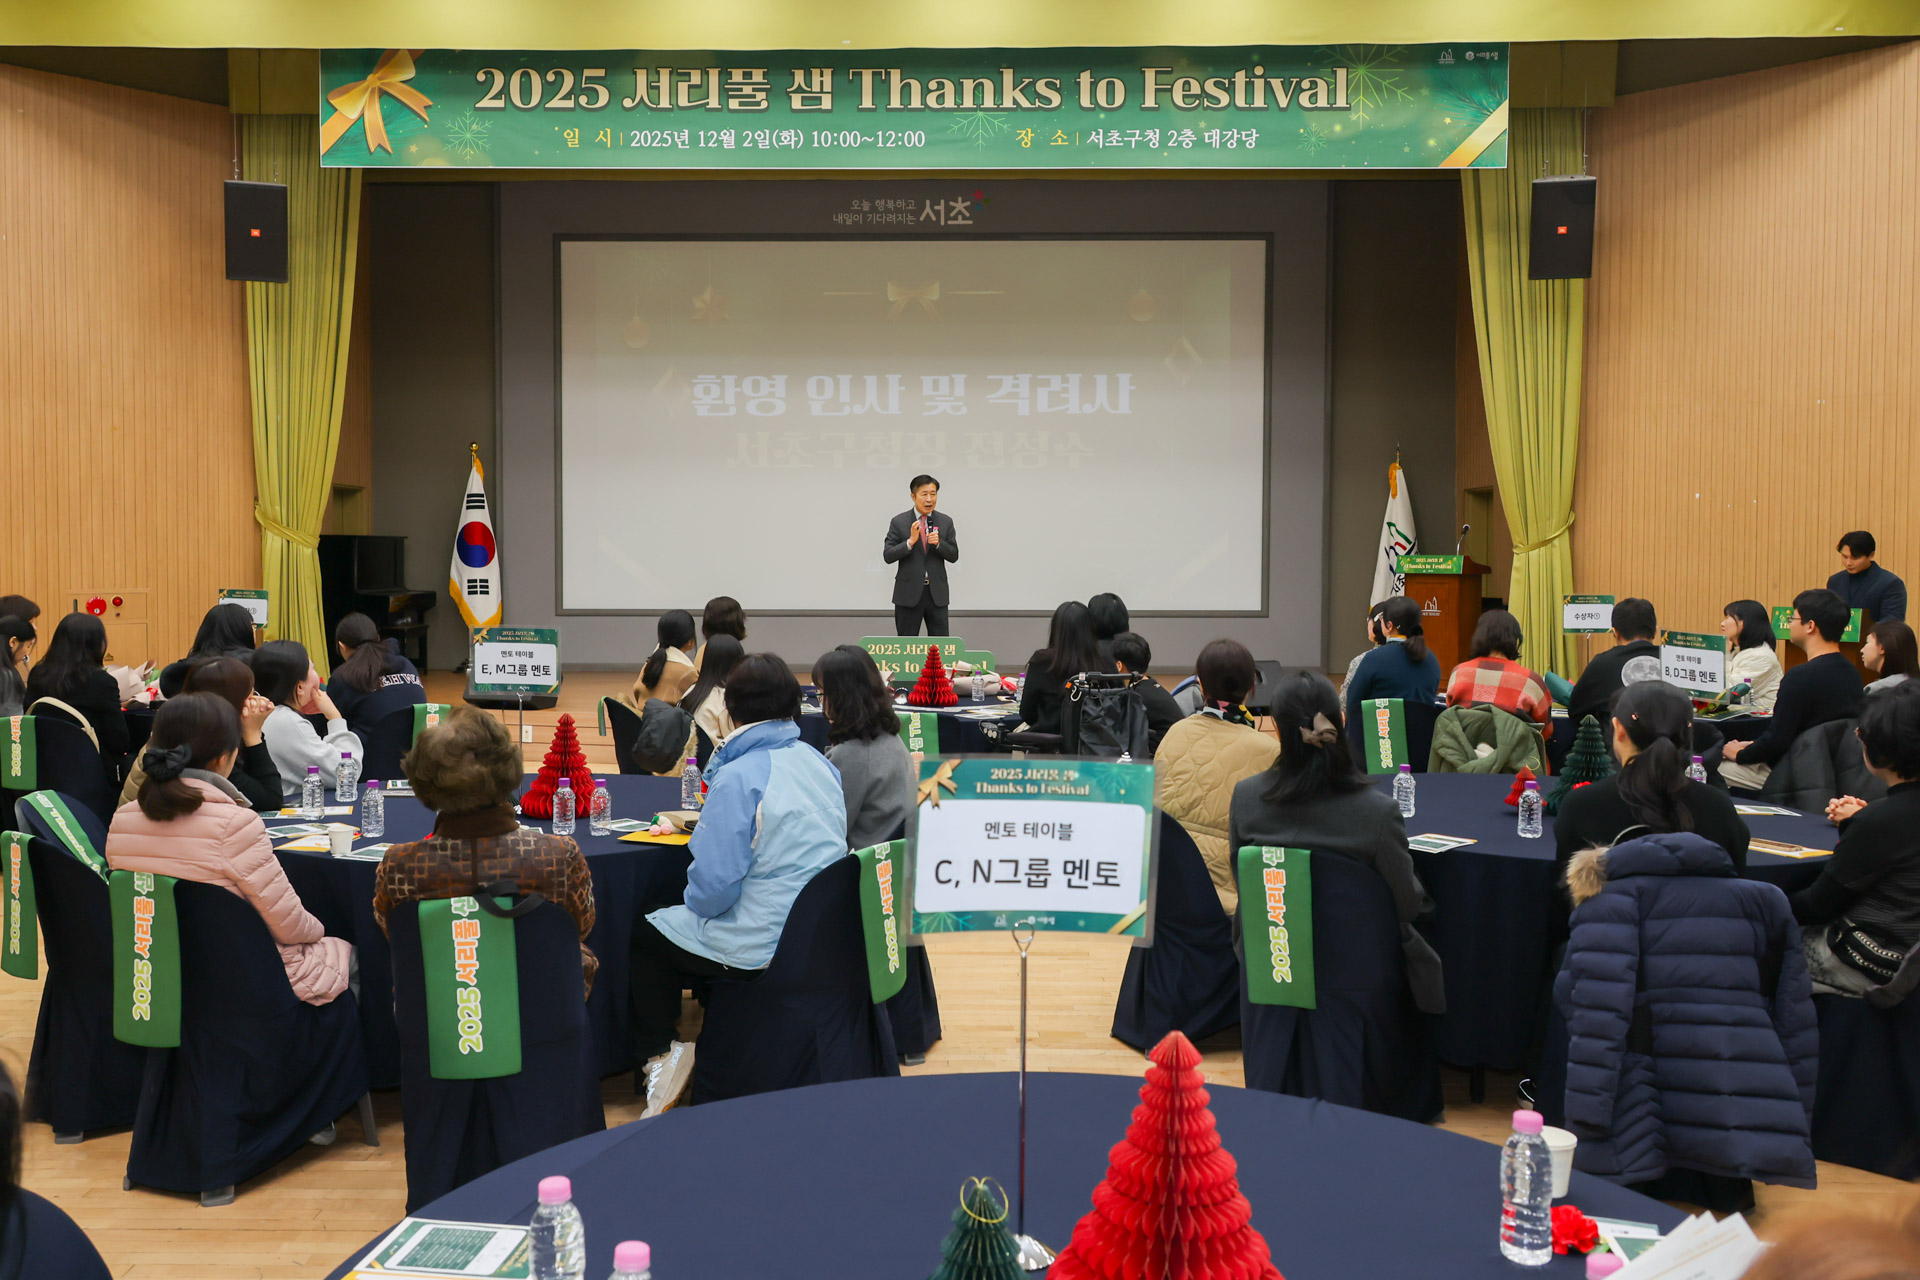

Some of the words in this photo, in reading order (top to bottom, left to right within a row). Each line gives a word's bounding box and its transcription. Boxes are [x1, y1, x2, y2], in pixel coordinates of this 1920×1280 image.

[474, 67, 611, 110] 2025
[622, 67, 772, 111] 서리풀
[786, 67, 835, 111] 샘
[848, 67, 1063, 110] Thanks
[1075, 68, 1127, 109] to
[1140, 65, 1352, 109] Festival
[563, 128, 580, 148] 일
[594, 128, 612, 148] 시
[630, 129, 691, 149] 2025년
[698, 129, 737, 149] 12월
[742, 129, 804, 150] 2일(화)
[811, 130, 926, 149] 10:00~12:00
[1015, 128, 1035, 148] 장
[1050, 129, 1069, 146] 소
[1086, 128, 1161, 149] 서초구청
[1167, 129, 1197, 149] 2층
[1203, 128, 1260, 149] 대강당
[832, 213, 863, 225] 내일이
[866, 213, 917, 225] 기다려지는
[850, 199, 871, 211] 오늘
[875, 199, 917, 211] 행복하고
[919, 196, 974, 226] 서초
[691, 373, 788, 417] 환영
[805, 373, 905, 416] 인사
[919, 373, 968, 417] 및
[985, 373, 1136, 416] 격려사
[726, 430, 954, 470] 서초구청장
[962, 430, 1096, 470] 전성수
[501, 650, 514, 658] 멘토
[515, 650, 534, 659] 테이블
[867, 643, 901, 655] 2025
[944, 644, 956, 656] 샘
[481, 664, 492, 676] E,
[496, 664, 528, 677] M그룹
[531, 664, 552, 677] 멘토
[904, 661, 920, 673] to
[1673, 667, 1697, 682] D그룹
[1698, 670, 1718, 684] 멘토
[1375, 708, 1390, 738] 서리풀
[10, 743, 22, 778] 2025
[1378, 738, 1393, 769] 2025
[975, 781, 1024, 794] Thanks
[1026, 783, 1039, 794] to
[1040, 783, 1090, 796] Festival
[990, 768, 1023, 780] 2025
[984, 822, 1017, 840] 멘토
[1023, 822, 1074, 841] 테이블
[10, 843, 21, 899] 서리풀
[934, 860, 960, 889] C,
[972, 858, 1052, 889] N그룹
[1062, 859, 1121, 890] 멘토
[876, 859, 894, 915] 서리풀
[1263, 867, 1287, 926] 서리풀
[10, 899, 21, 955] 2025
[133, 896, 155, 959] 서리풀
[451, 919, 481, 986] 서리풀
[884, 916, 900, 974] 2025
[1268, 926, 1293, 983] 2025
[132, 959, 152, 1021] 2025
[457, 987, 483, 1055] 2025
